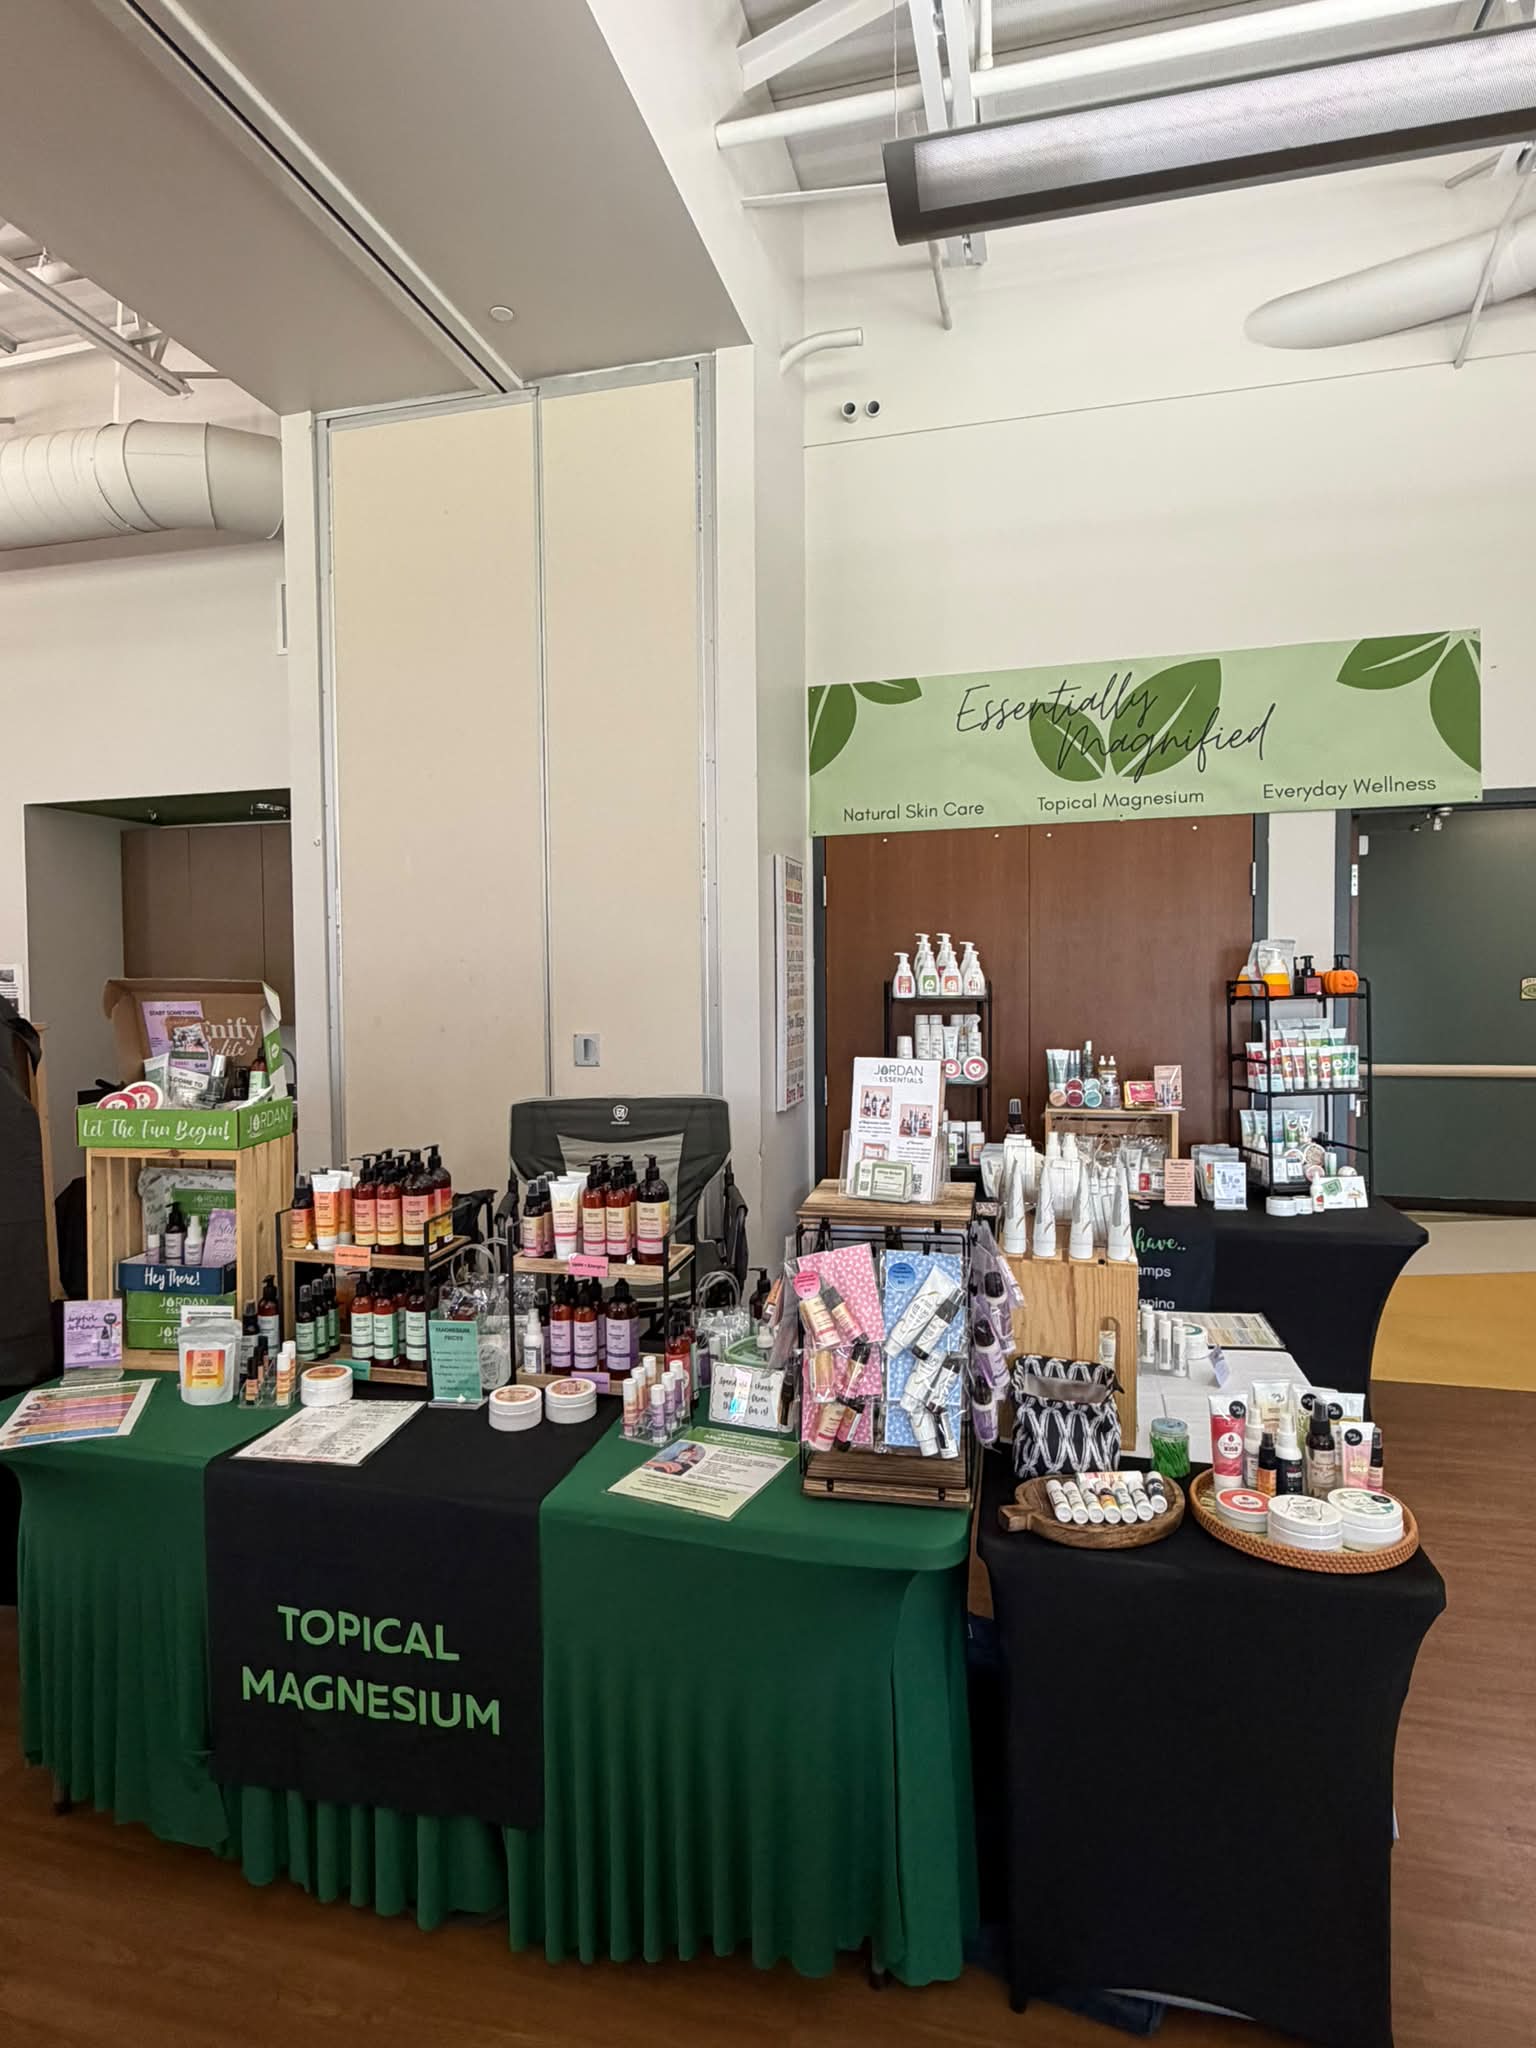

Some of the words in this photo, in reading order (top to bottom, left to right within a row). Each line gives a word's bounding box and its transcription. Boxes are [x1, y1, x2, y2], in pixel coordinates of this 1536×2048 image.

[956, 672, 1158, 732] Essentially
[1058, 703, 1276, 783] Magnified
[1037, 793, 1097, 812] Topical
[1103, 791, 1204, 810] Magnesium
[1263, 780, 1347, 802] Everyday
[1353, 776, 1437, 794] Wellness
[843, 804, 900, 822] Natural
[905, 804, 938, 819] Skin
[943, 802, 985, 817] Care
[205, 1017, 259, 1045] nify
[874, 1064, 924, 1076] JORDAN
[83, 1119, 104, 1137] Let
[112, 1118, 136, 1137] The
[142, 1119, 170, 1137] Fun
[174, 1119, 231, 1144] Begin!
[248, 1106, 289, 1134] JORDAN
[145, 1267, 167, 1290] Hey
[168, 1268, 200, 1287] There!
[159, 1296, 208, 1307] JORDAN
[277, 1604, 460, 1661] TOPICAL
[242, 1665, 500, 1736] MAGNESIUM
